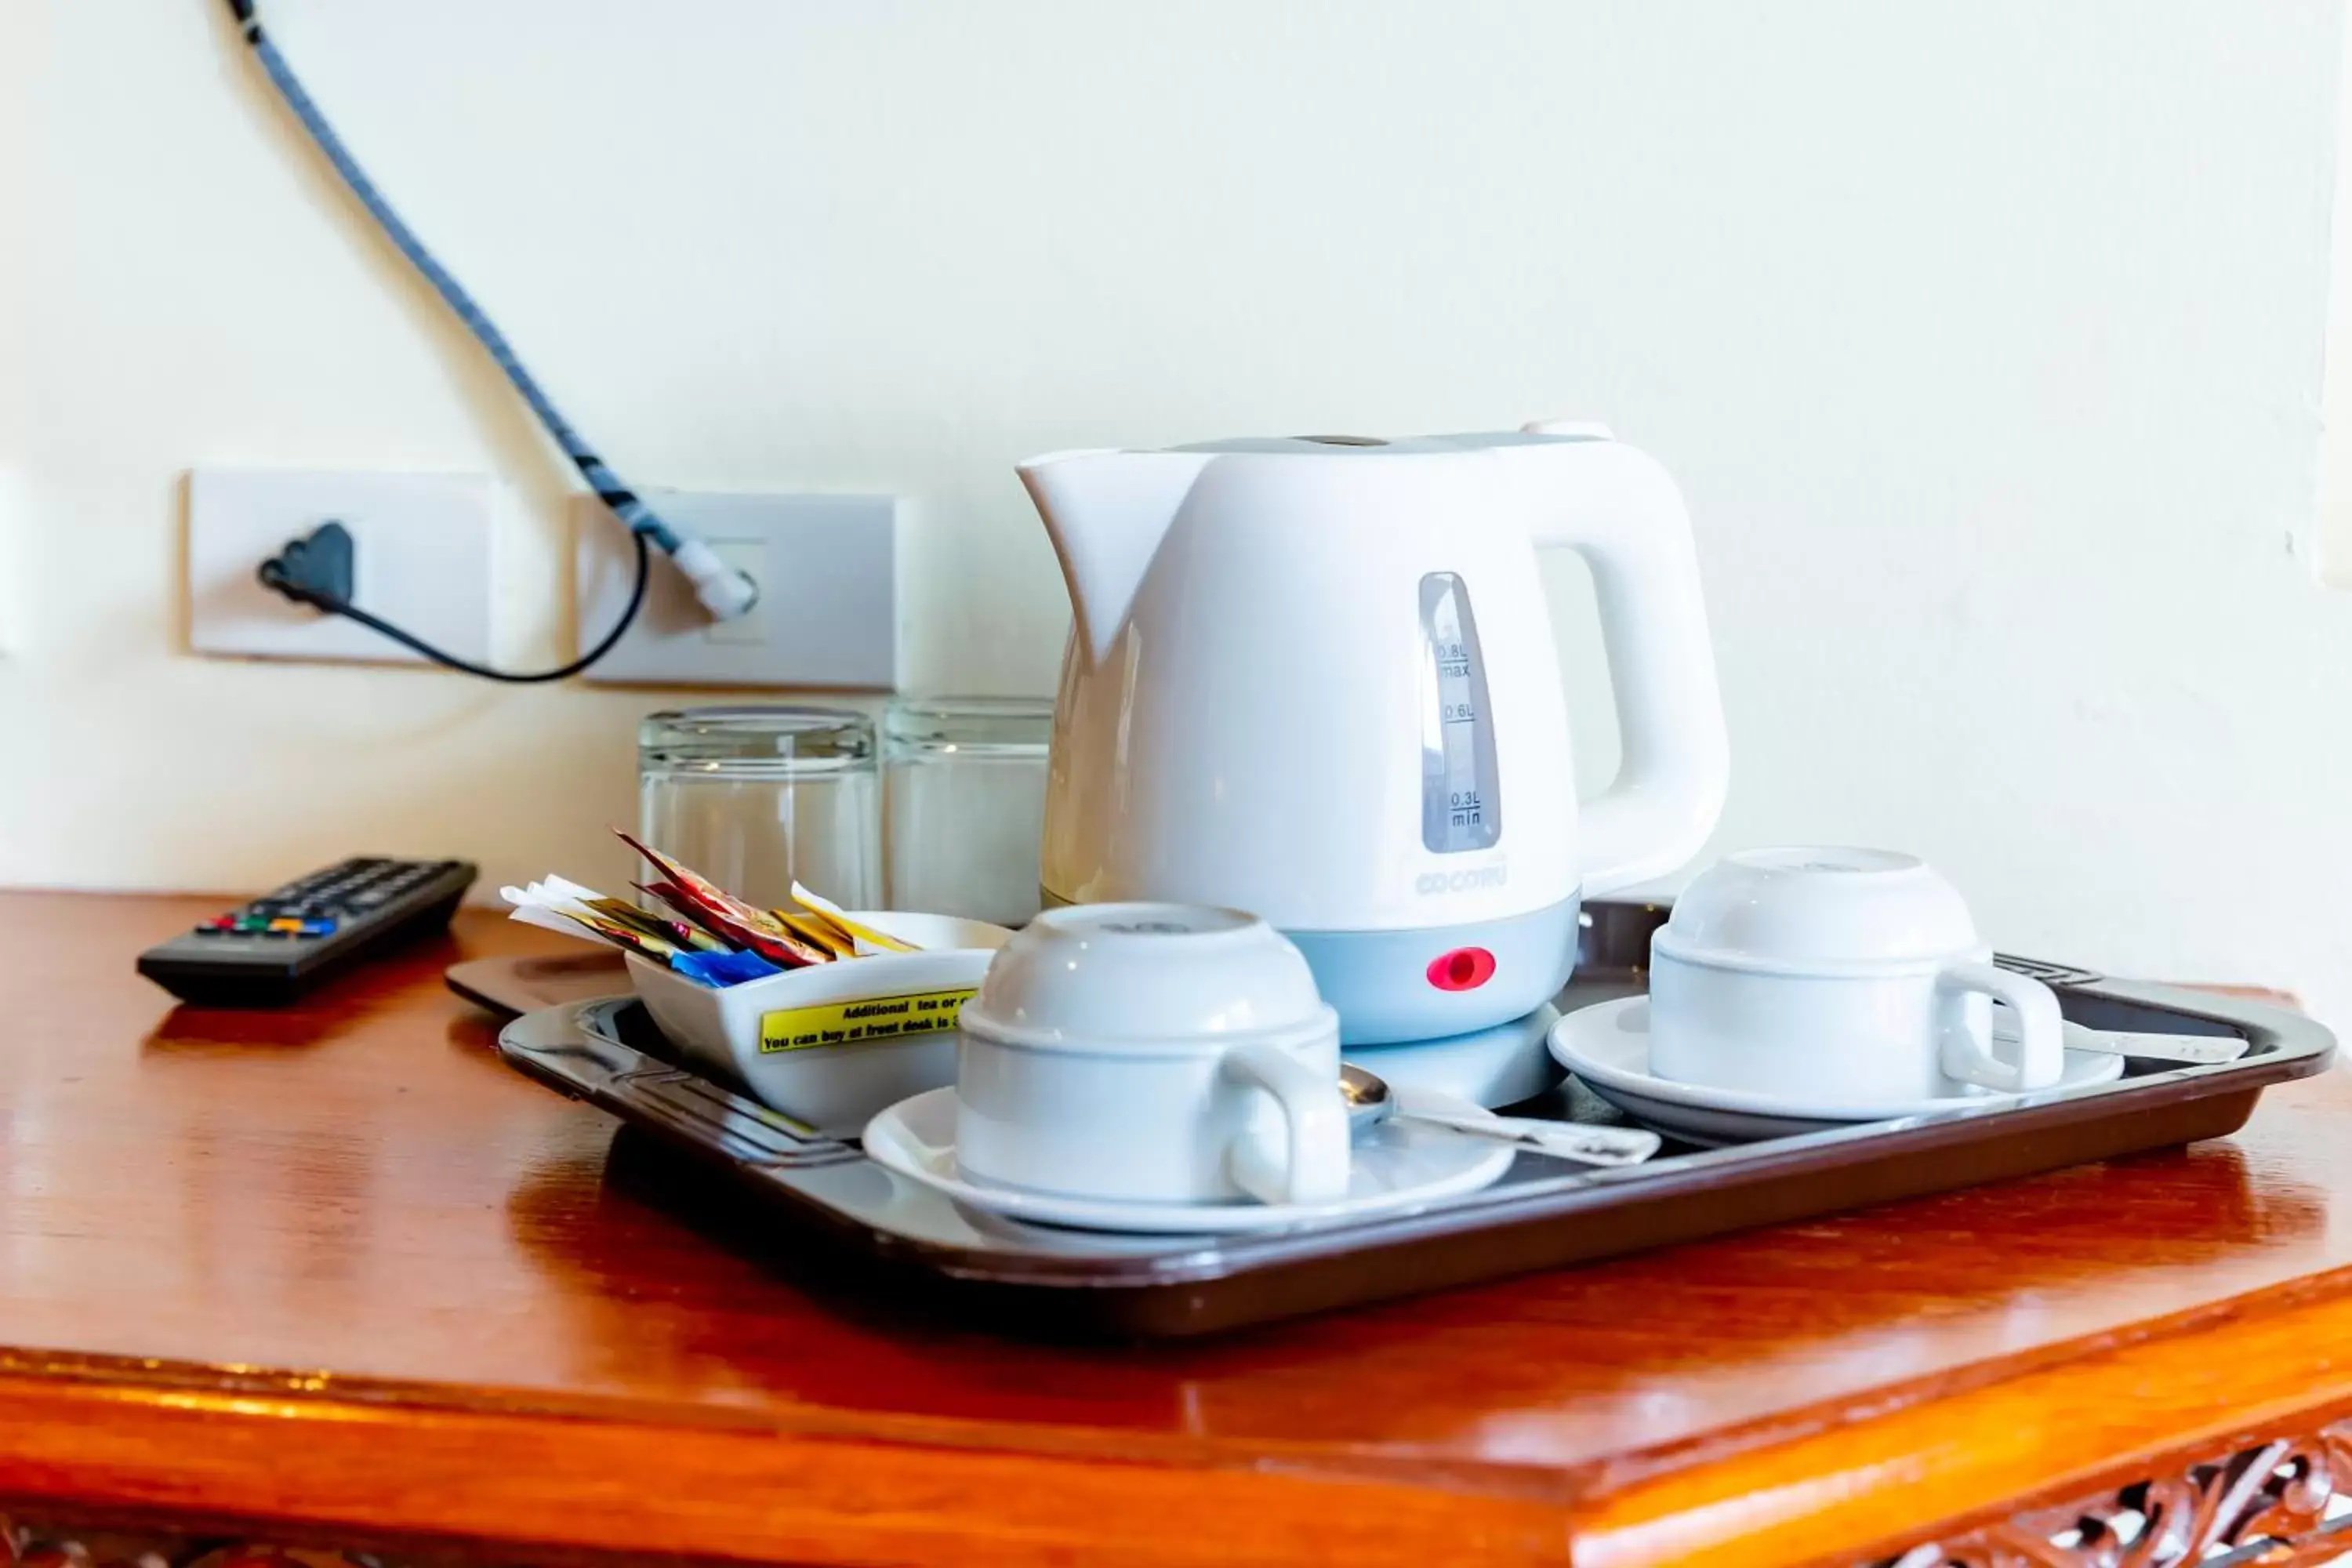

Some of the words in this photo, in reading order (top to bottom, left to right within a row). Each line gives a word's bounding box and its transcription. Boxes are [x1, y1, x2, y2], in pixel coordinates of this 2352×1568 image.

[1445, 703, 1474, 718] 0.6L
[1451, 790, 1480, 806] 0.3L
[1452, 808, 1480, 826] min
[843, 1001, 909, 1019] Additional
[917, 1000, 938, 1011] tea
[942, 997, 957, 1008] or
[764, 1037, 789, 1049] You
[793, 1034, 818, 1045] can
[821, 1029, 845, 1042] buy
[866, 1022, 899, 1036] front
